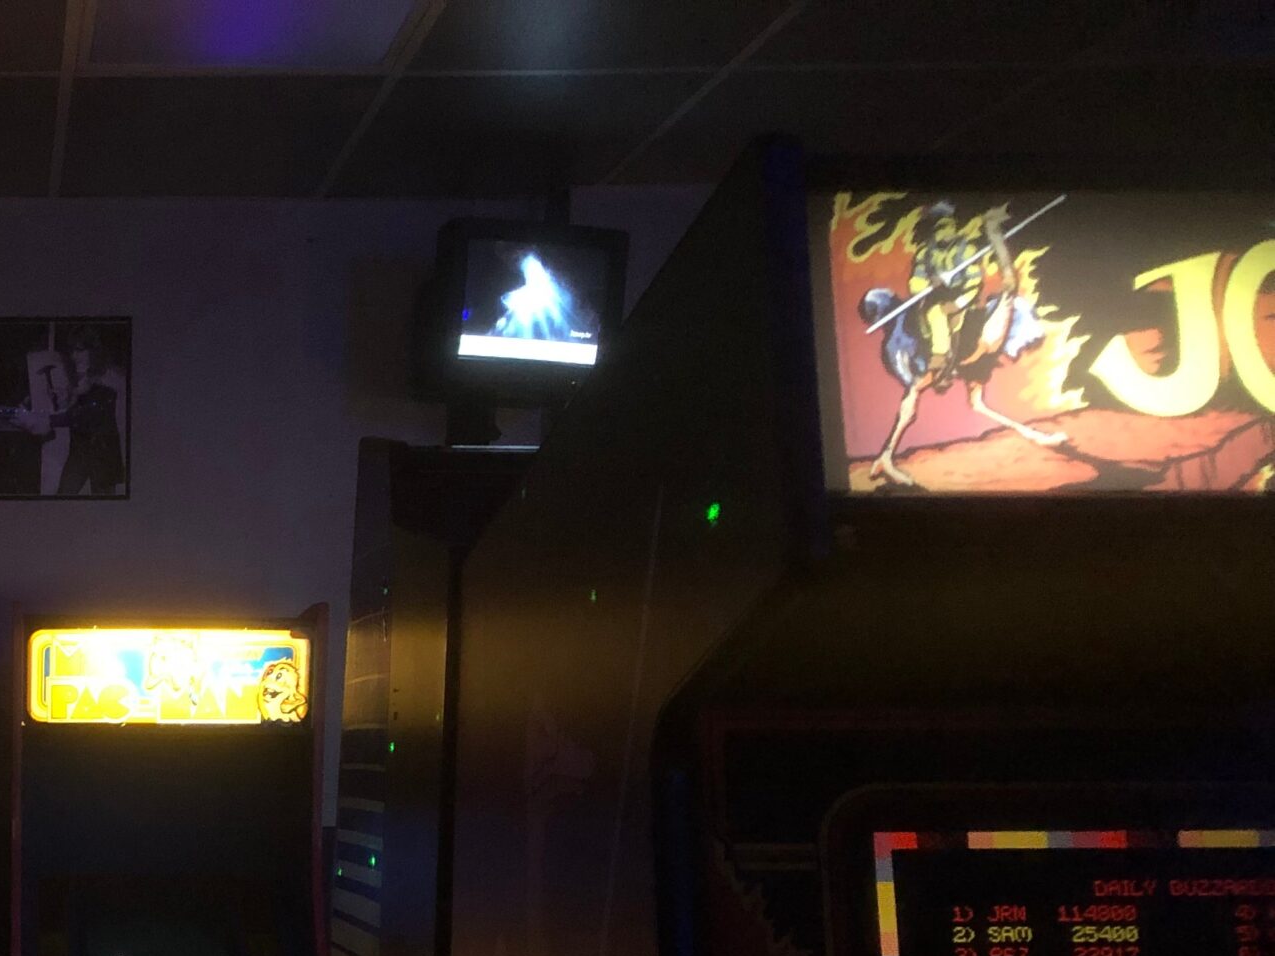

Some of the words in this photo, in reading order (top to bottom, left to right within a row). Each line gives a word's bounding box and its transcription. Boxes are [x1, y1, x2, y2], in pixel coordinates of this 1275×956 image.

[952, 926, 976, 943] 2)
[987, 926, 1033, 943] SAM
[1071, 925, 1139, 943] 25400
